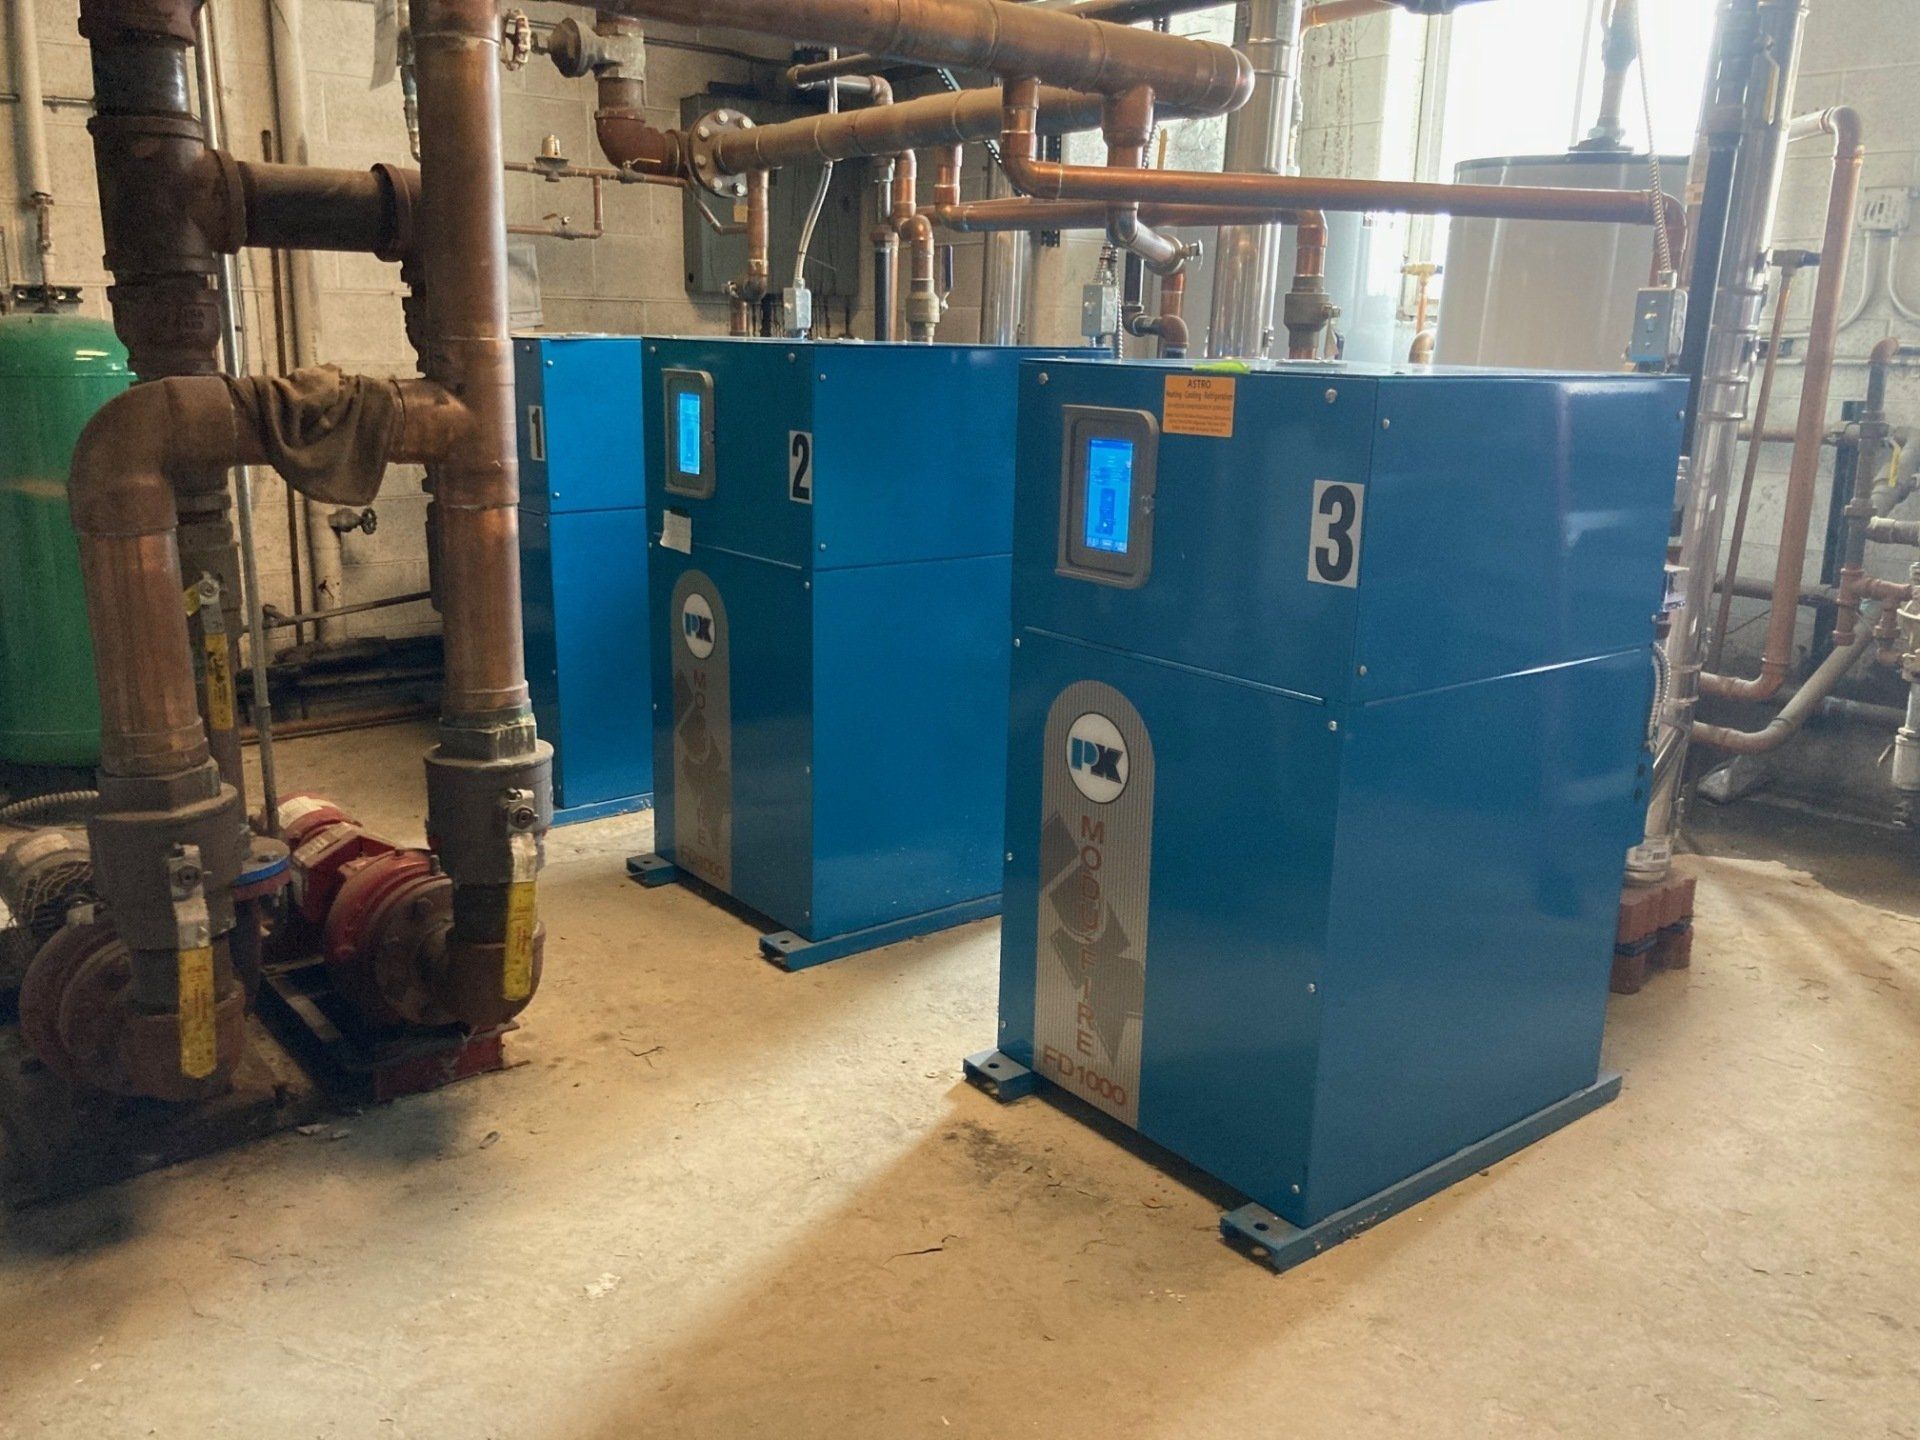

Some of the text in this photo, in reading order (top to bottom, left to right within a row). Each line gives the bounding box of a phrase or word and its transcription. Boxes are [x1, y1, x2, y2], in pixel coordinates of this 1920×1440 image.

[1187, 379, 1211, 389] ASTRO
[532, 408, 542, 458] 1
[791, 434, 810, 499] 2
[1315, 485, 1356, 581] 3
[685, 612, 712, 643] PK
[1071, 737, 1124, 785] PK
[1043, 1044, 1127, 1105] FD1000
